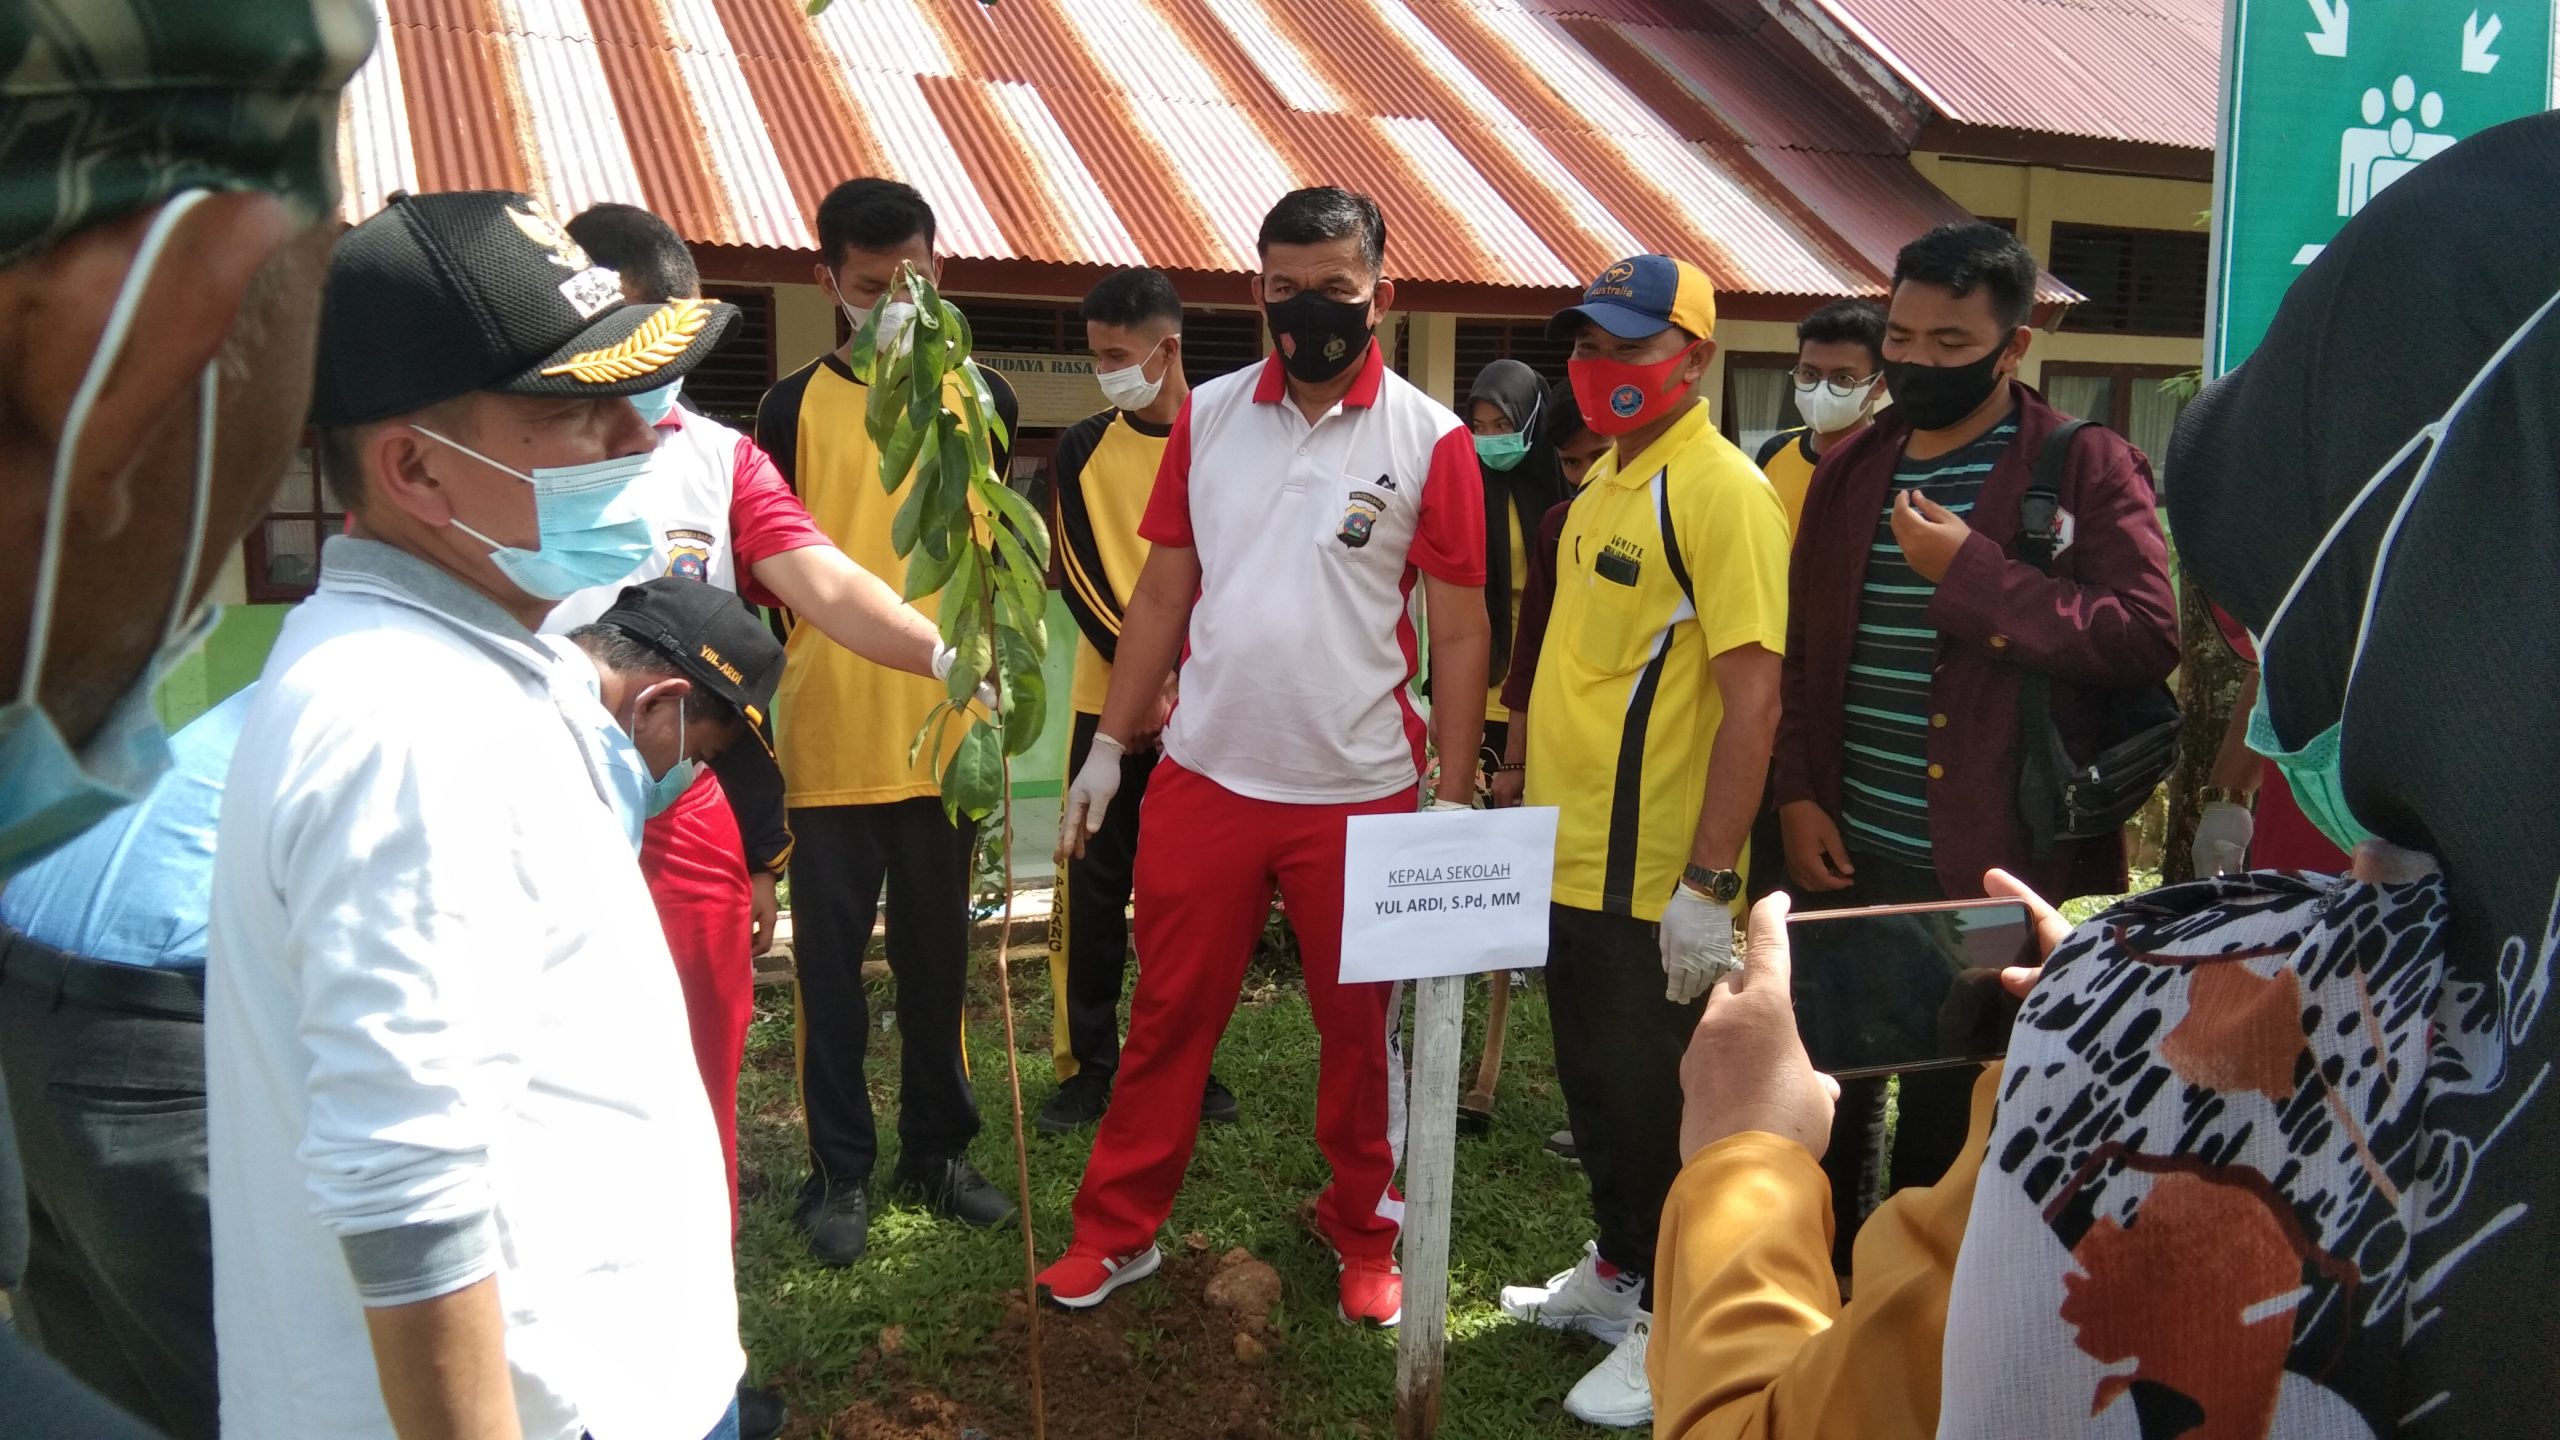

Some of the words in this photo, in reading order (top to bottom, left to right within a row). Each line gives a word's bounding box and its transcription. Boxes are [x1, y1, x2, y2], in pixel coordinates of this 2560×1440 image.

[1051, 361, 1094, 375] RASA
[700, 644, 720, 668] YUL
[719, 662, 744, 686] ARDI
[1388, 867, 1442, 884] KEPALA
[1446, 862, 1511, 881] SEKOLAH
[1049, 876, 1064, 952] PADANG
[1375, 901, 1403, 915] YUL
[1406, 897, 1447, 912] ARDI,
[1451, 893, 1487, 910] S.Pd,
[1491, 892, 1521, 906] MM
